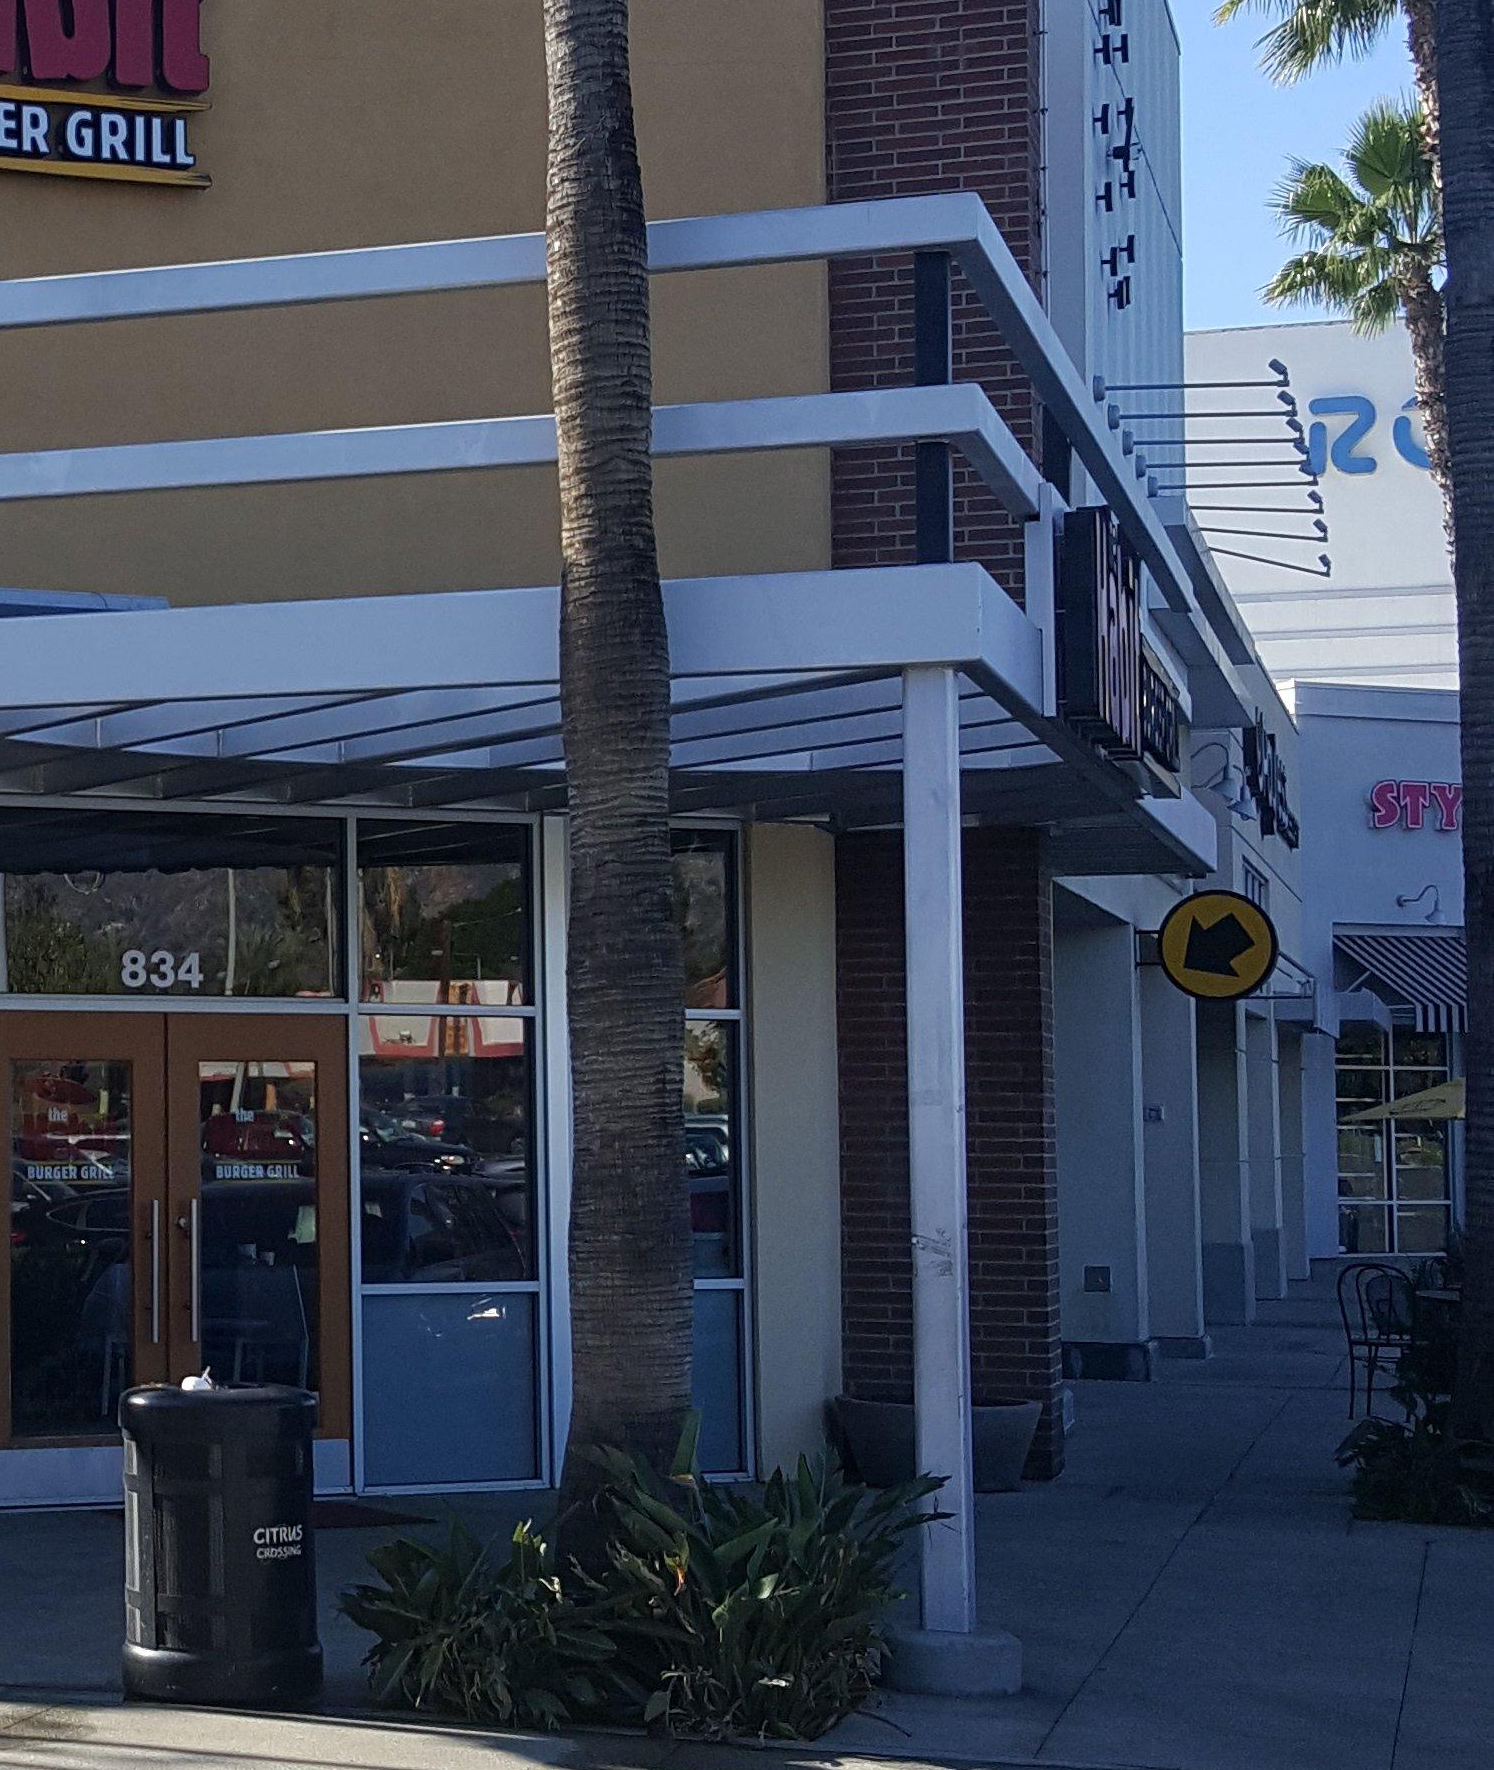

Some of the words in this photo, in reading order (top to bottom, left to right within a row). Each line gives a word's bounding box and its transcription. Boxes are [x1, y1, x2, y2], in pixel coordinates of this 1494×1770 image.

[64, 110, 196, 167] GRILL
[1371, 779, 1463, 831] STY
[121, 949, 204, 989] 834
[47, 1107, 68, 1122] the
[27, 1165, 77, 1180] BURGER
[80, 1165, 115, 1180] GRILL
[216, 1165, 264, 1179] BURGER
[266, 1164, 300, 1179] GRILL
[253, 1524, 303, 1545] CITRUS
[256, 1545, 302, 1559] CROSSING
